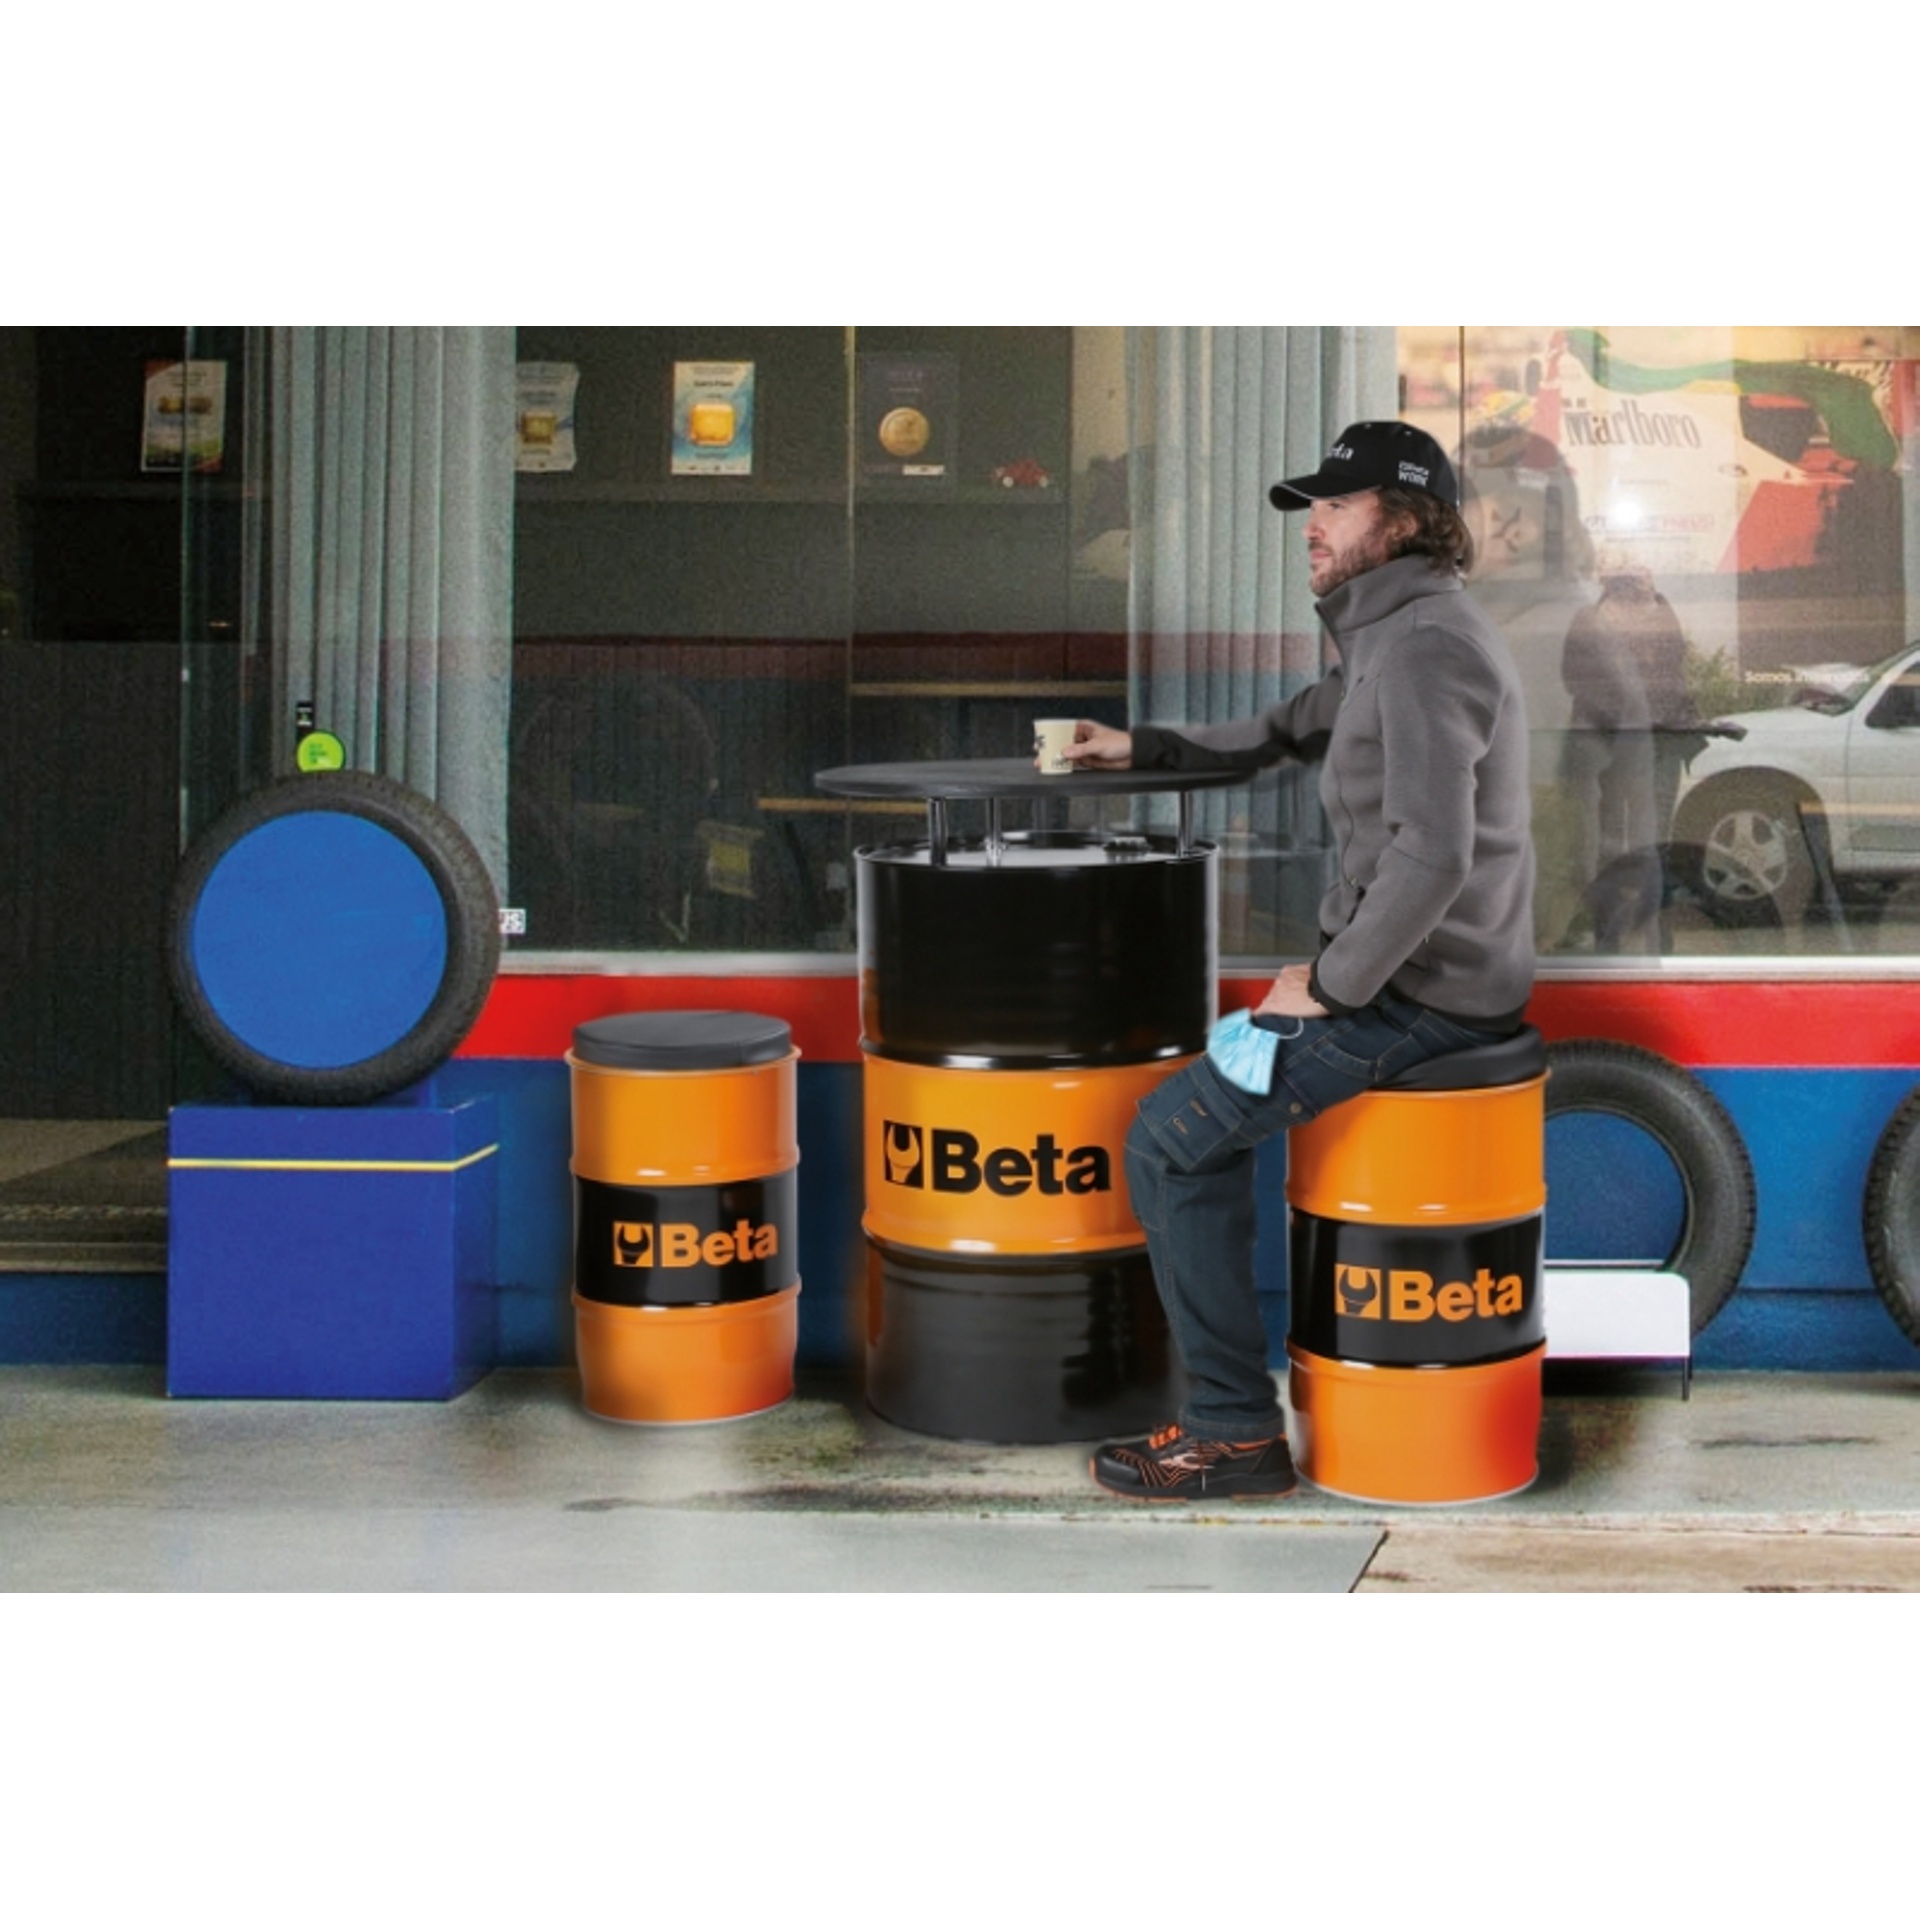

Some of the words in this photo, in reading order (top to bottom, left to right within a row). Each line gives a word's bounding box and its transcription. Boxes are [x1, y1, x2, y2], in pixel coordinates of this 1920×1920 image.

[1564, 399, 1702, 449] Marlboro
[931, 1127, 1111, 1196] Beta
[660, 1219, 778, 1268] Beta
[1389, 1268, 1523, 1323] Beta
